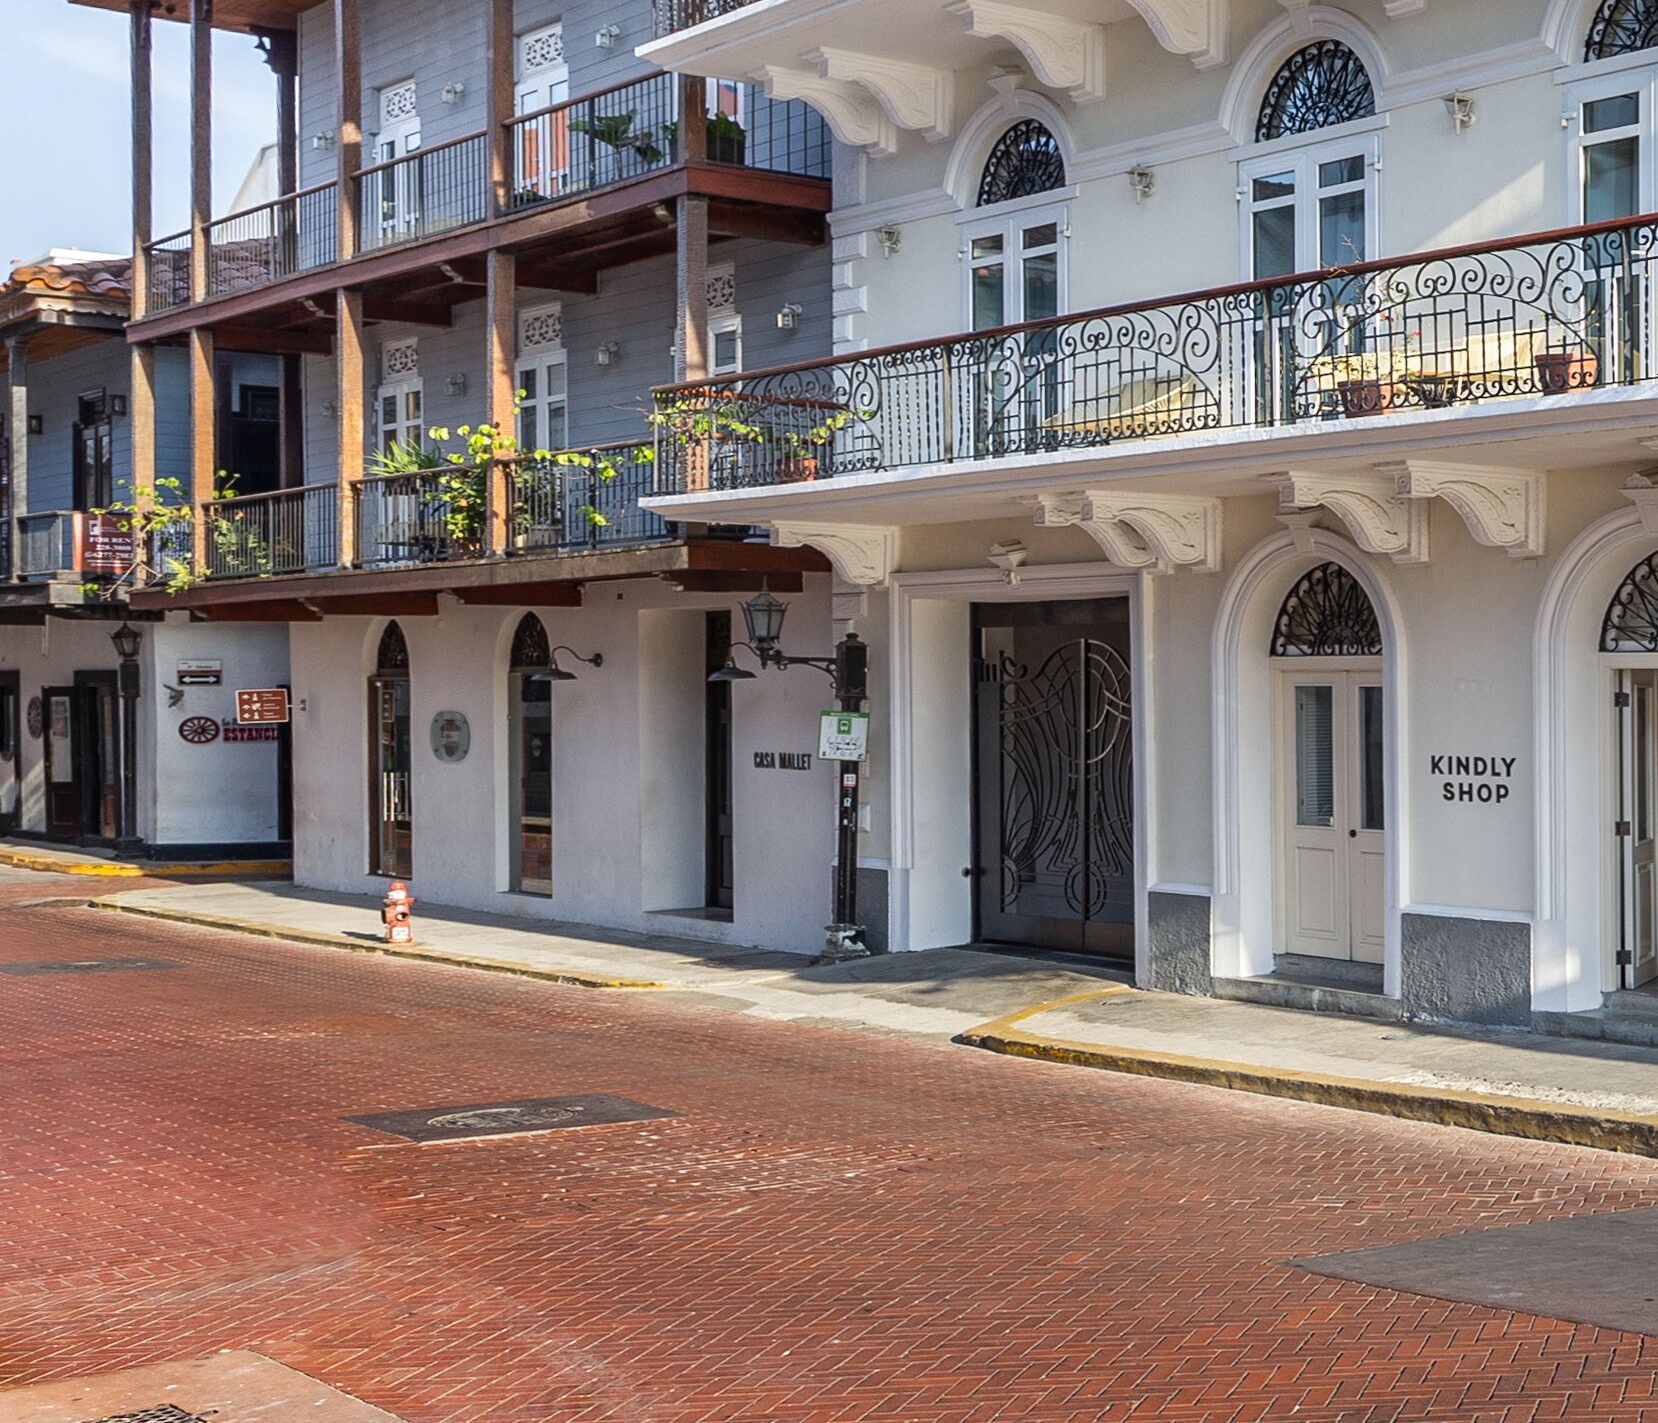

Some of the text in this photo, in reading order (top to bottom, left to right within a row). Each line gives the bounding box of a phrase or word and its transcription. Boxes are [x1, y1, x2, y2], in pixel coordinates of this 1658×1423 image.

[223, 727, 280, 742] ESTANCI
[753, 751, 812, 770] CASA MALLET
[1430, 755, 1517, 778] KINDLY
[1443, 781, 1510, 804] SHOP
